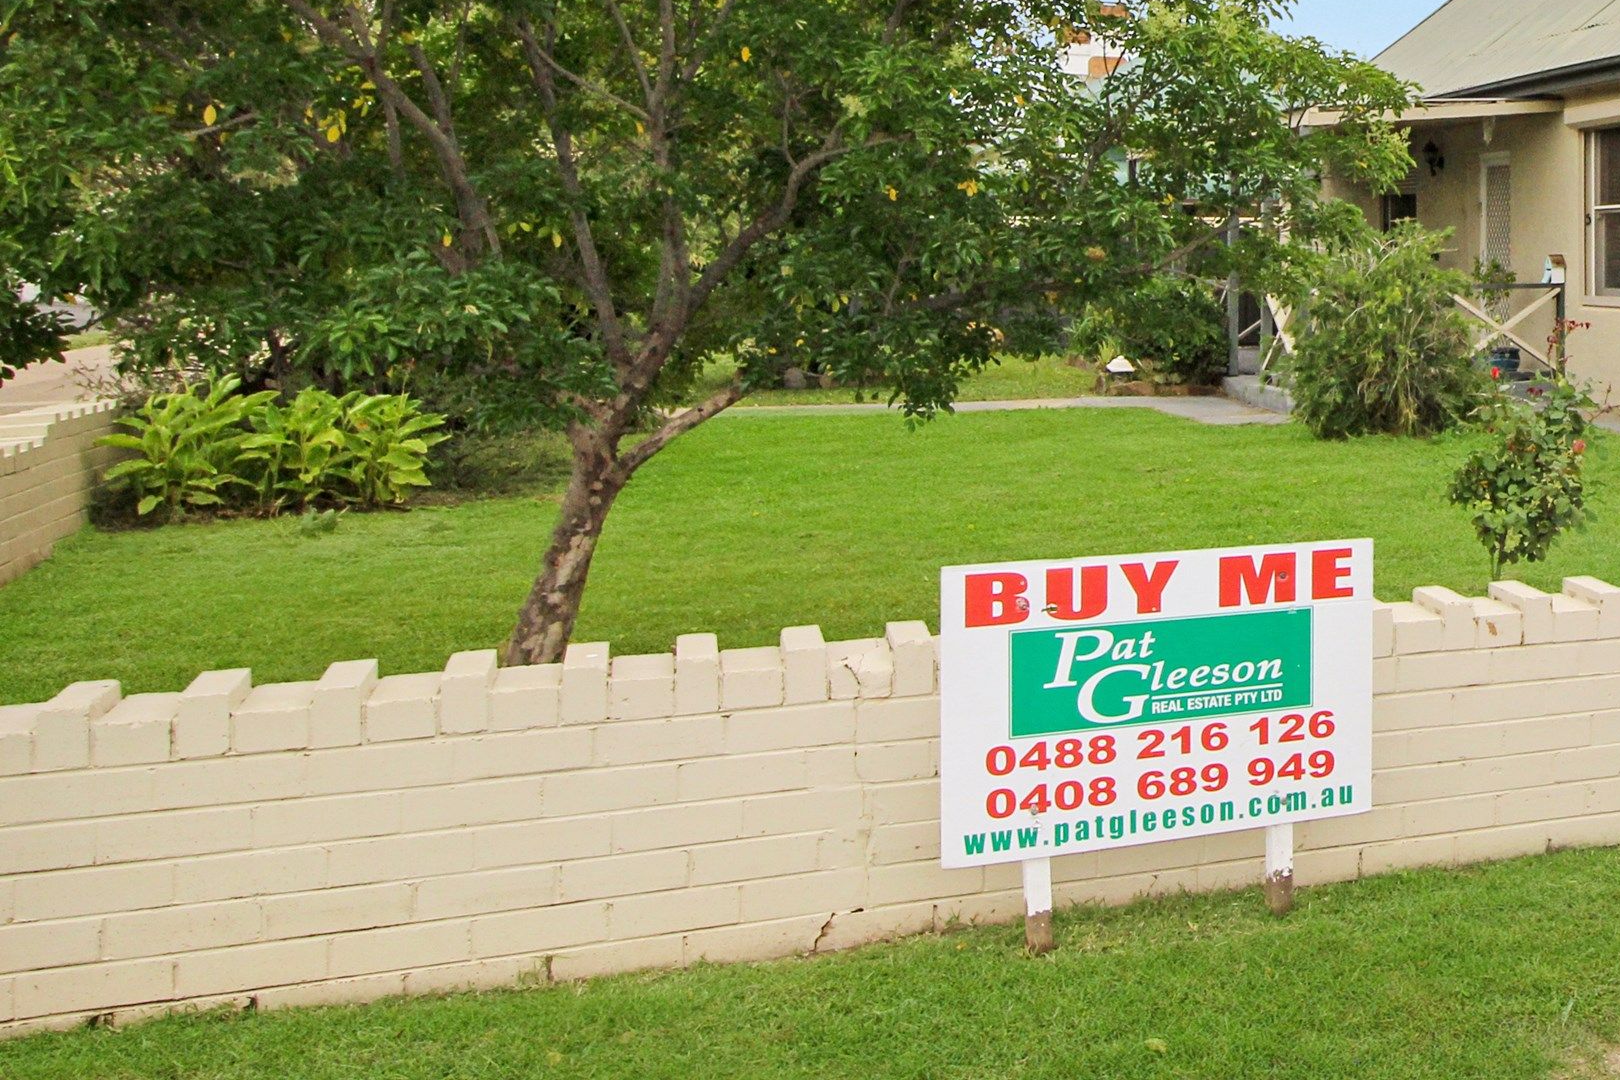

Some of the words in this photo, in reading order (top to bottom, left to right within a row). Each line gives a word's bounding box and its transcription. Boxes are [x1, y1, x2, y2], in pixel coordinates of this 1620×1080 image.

[965, 560, 1180, 628] BUY
[1218, 547, 1354, 607] ME
[1043, 629, 1156, 690] Pat
[1077, 658, 1283, 724] Gleeson
[1151, 699, 1185, 715] REAL
[1187, 693, 1232, 711] ESTATE
[1235, 691, 1259, 706] PTY
[1261, 688, 1283, 703] LTD
[985, 735, 1116, 777] 0488
[1137, 723, 1229, 760] 216
[1249, 710, 1336, 746] 126
[985, 777, 1116, 819] 0408
[1137, 763, 1229, 801] 689
[1248, 749, 1336, 787] 949
[963, 784, 1354, 856] www.patgleeson.com.au
